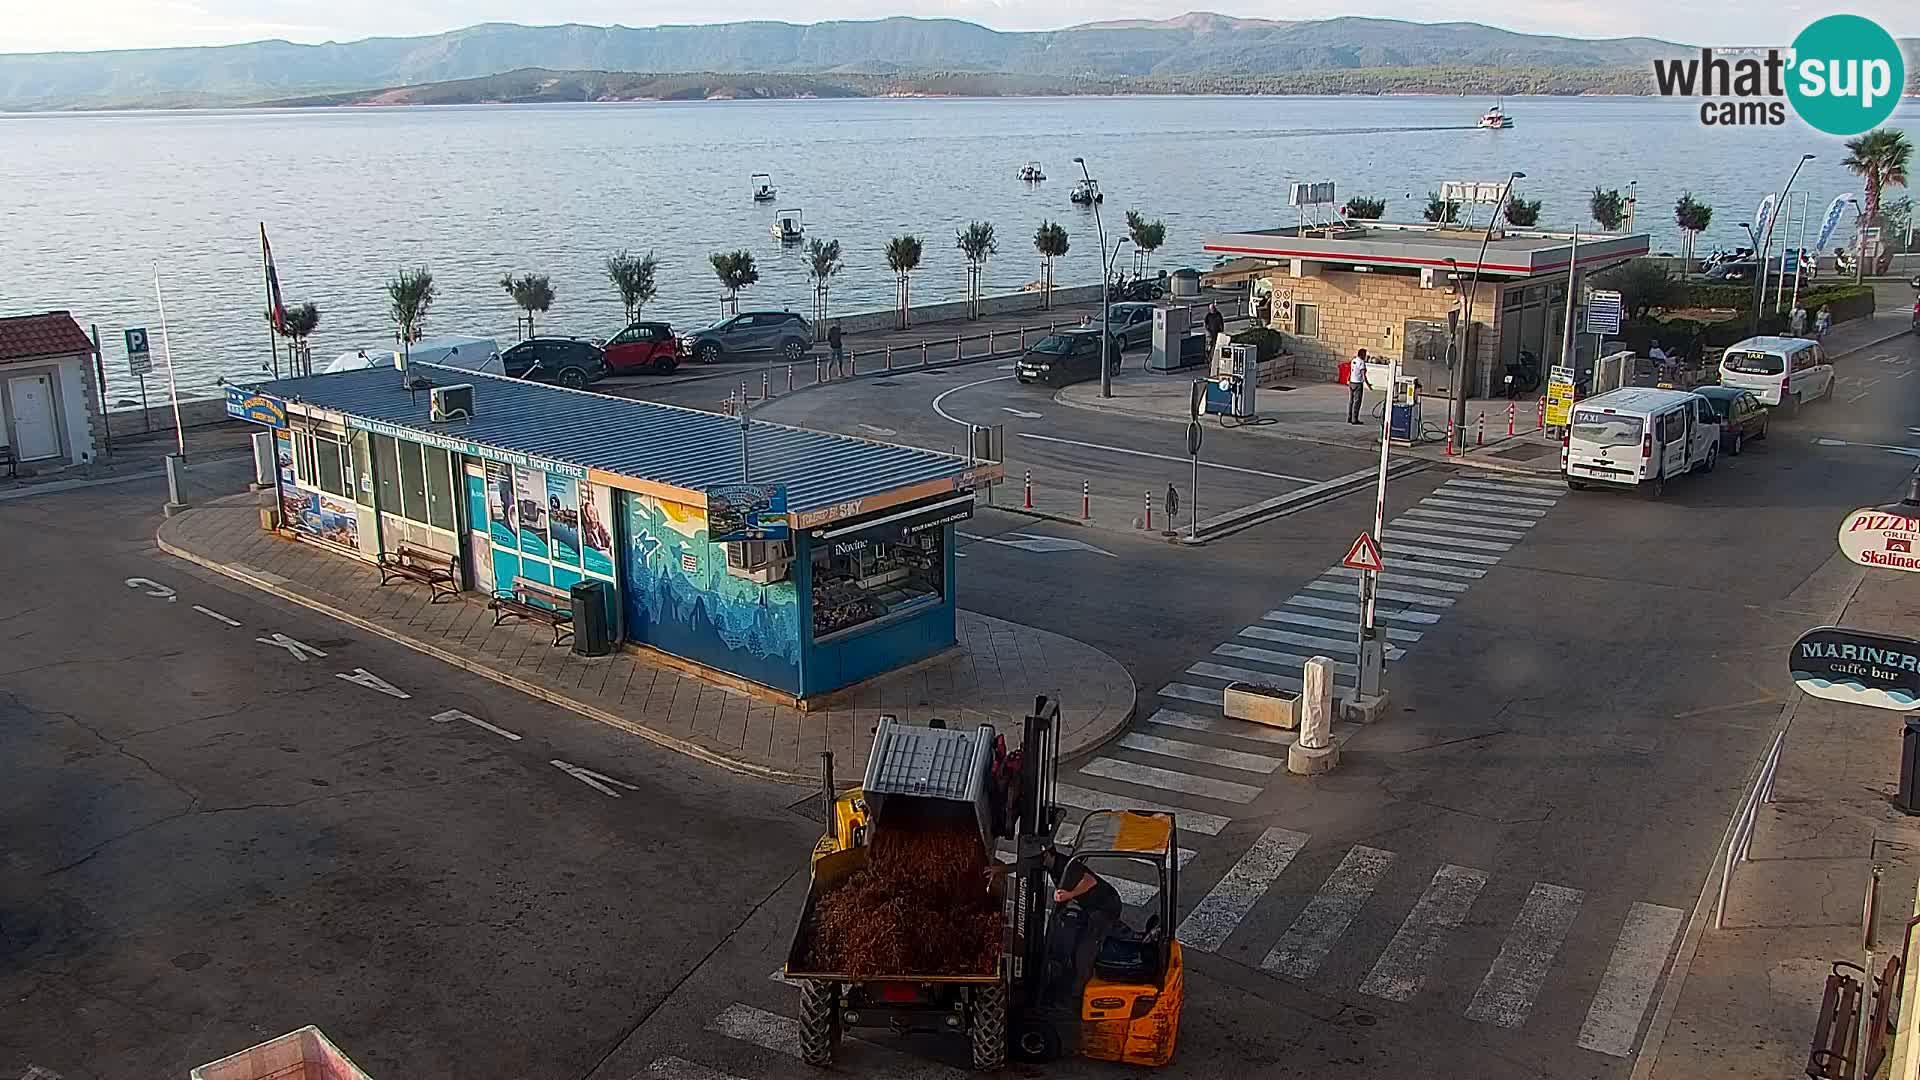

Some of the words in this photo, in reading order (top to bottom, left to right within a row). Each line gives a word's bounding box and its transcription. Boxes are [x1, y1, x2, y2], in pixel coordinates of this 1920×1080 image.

[130, 332, 143, 350] P
[1747, 352, 1764, 360] TAXI
[1578, 413, 1600, 423] TAXI
[437, 437, 468, 453] POSTAJA
[478, 446, 493, 458] BUS
[494, 450, 527, 465] STATION
[528, 457, 554, 472] TICKET
[555, 463, 583, 478] OFFICE
[839, 500, 862, 518] SKY
[1849, 515, 1920, 532] PIZZE
[1883, 531, 1918, 541] GRILL
[1801, 642, 1920, 673] MARINER
[1829, 662, 1867, 676] caffe
[1871, 666, 1899, 681] bar
